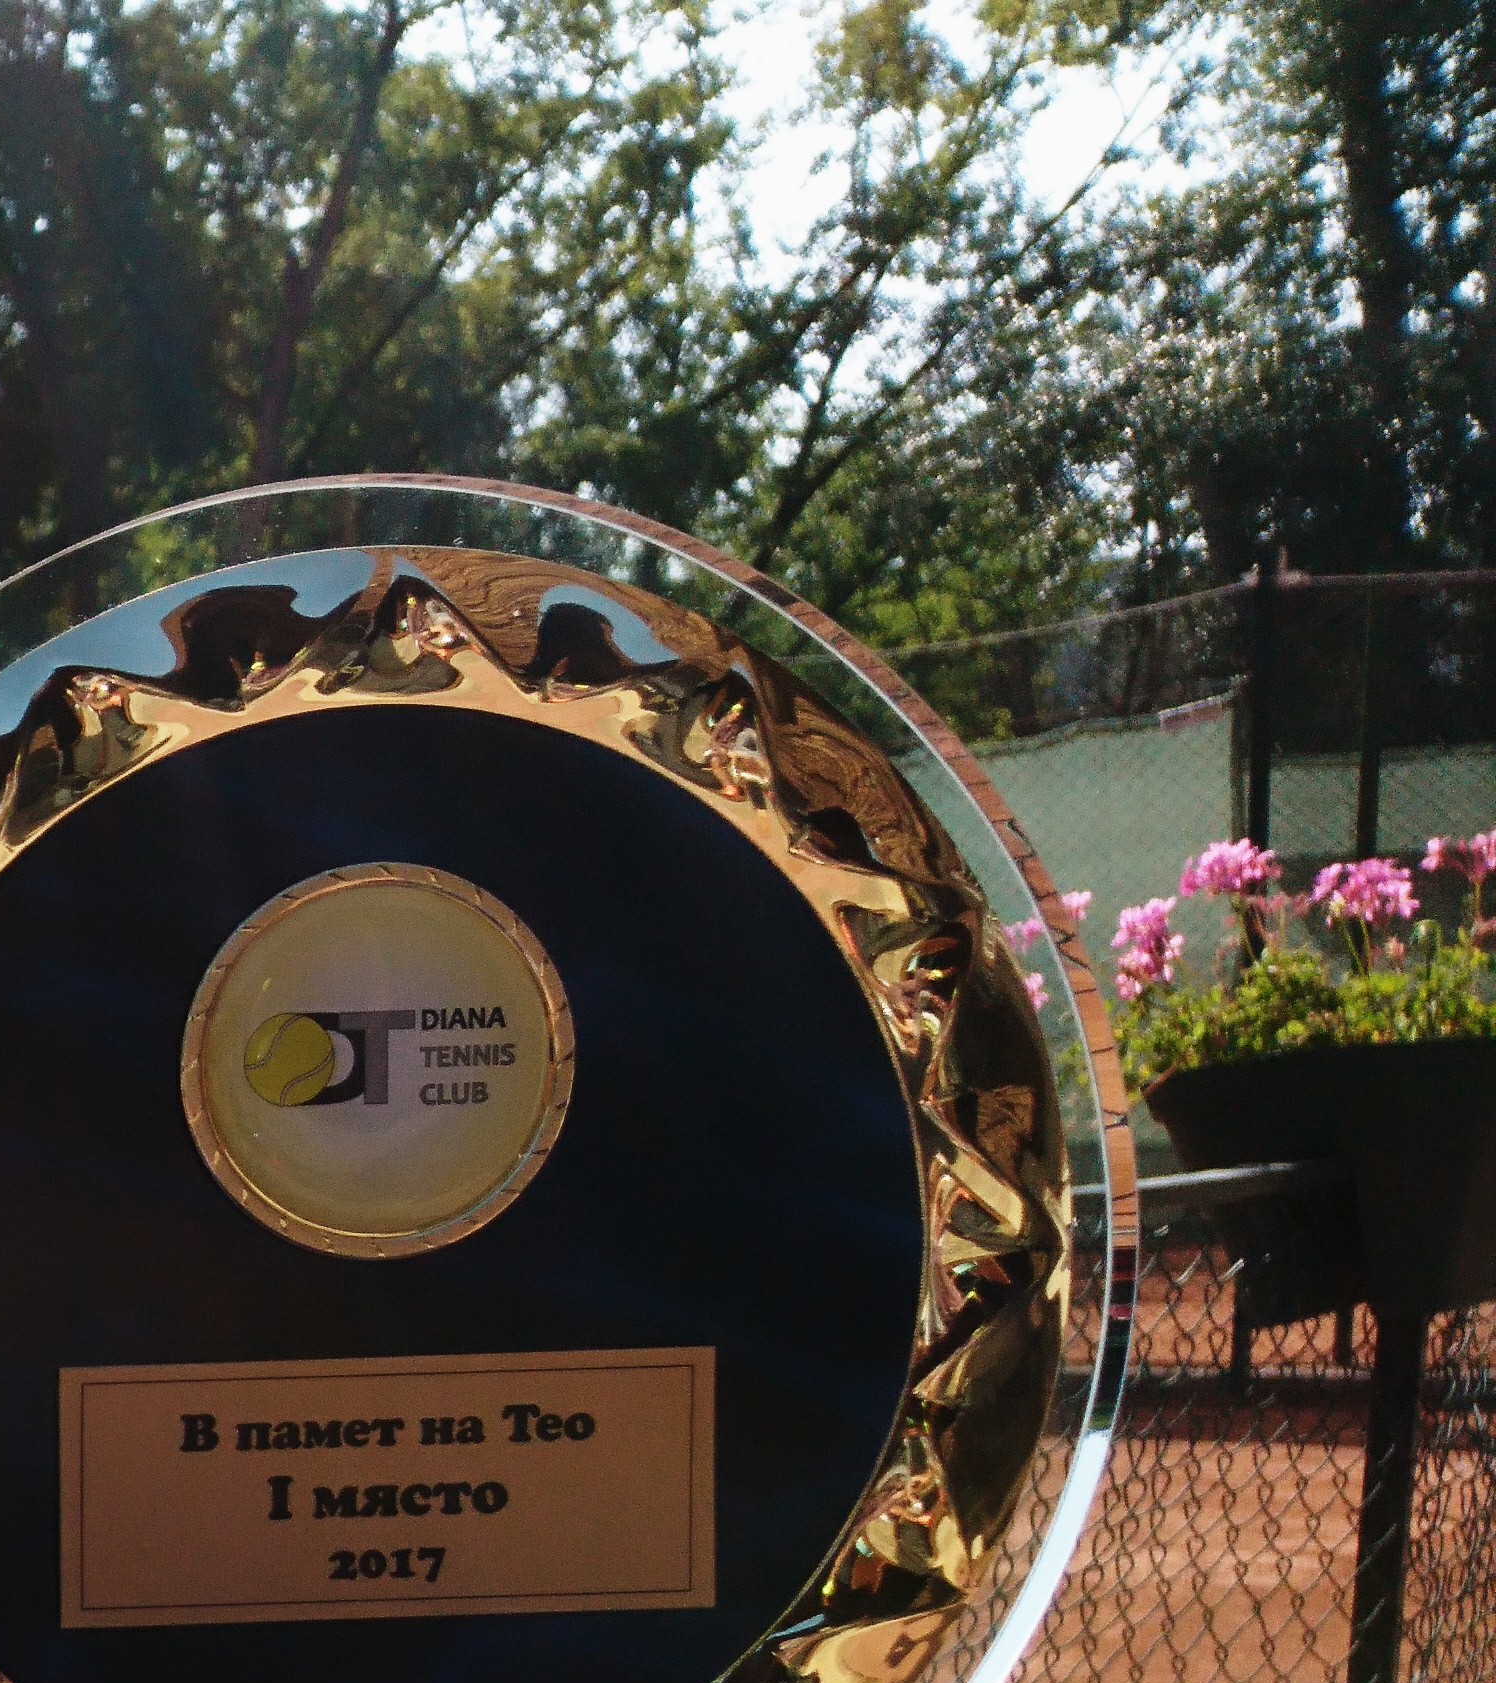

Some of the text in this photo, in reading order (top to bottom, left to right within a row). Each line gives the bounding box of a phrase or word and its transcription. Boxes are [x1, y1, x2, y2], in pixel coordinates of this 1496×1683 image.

[422, 1007, 506, 1030] DIANA
[420, 1043, 516, 1067] TENNIS
[420, 1082, 489, 1105] CLUB
[180, 1404, 595, 1452] В памет на Тео
[313, 1482, 508, 1519] място
[329, 1547, 445, 1582] 2017
